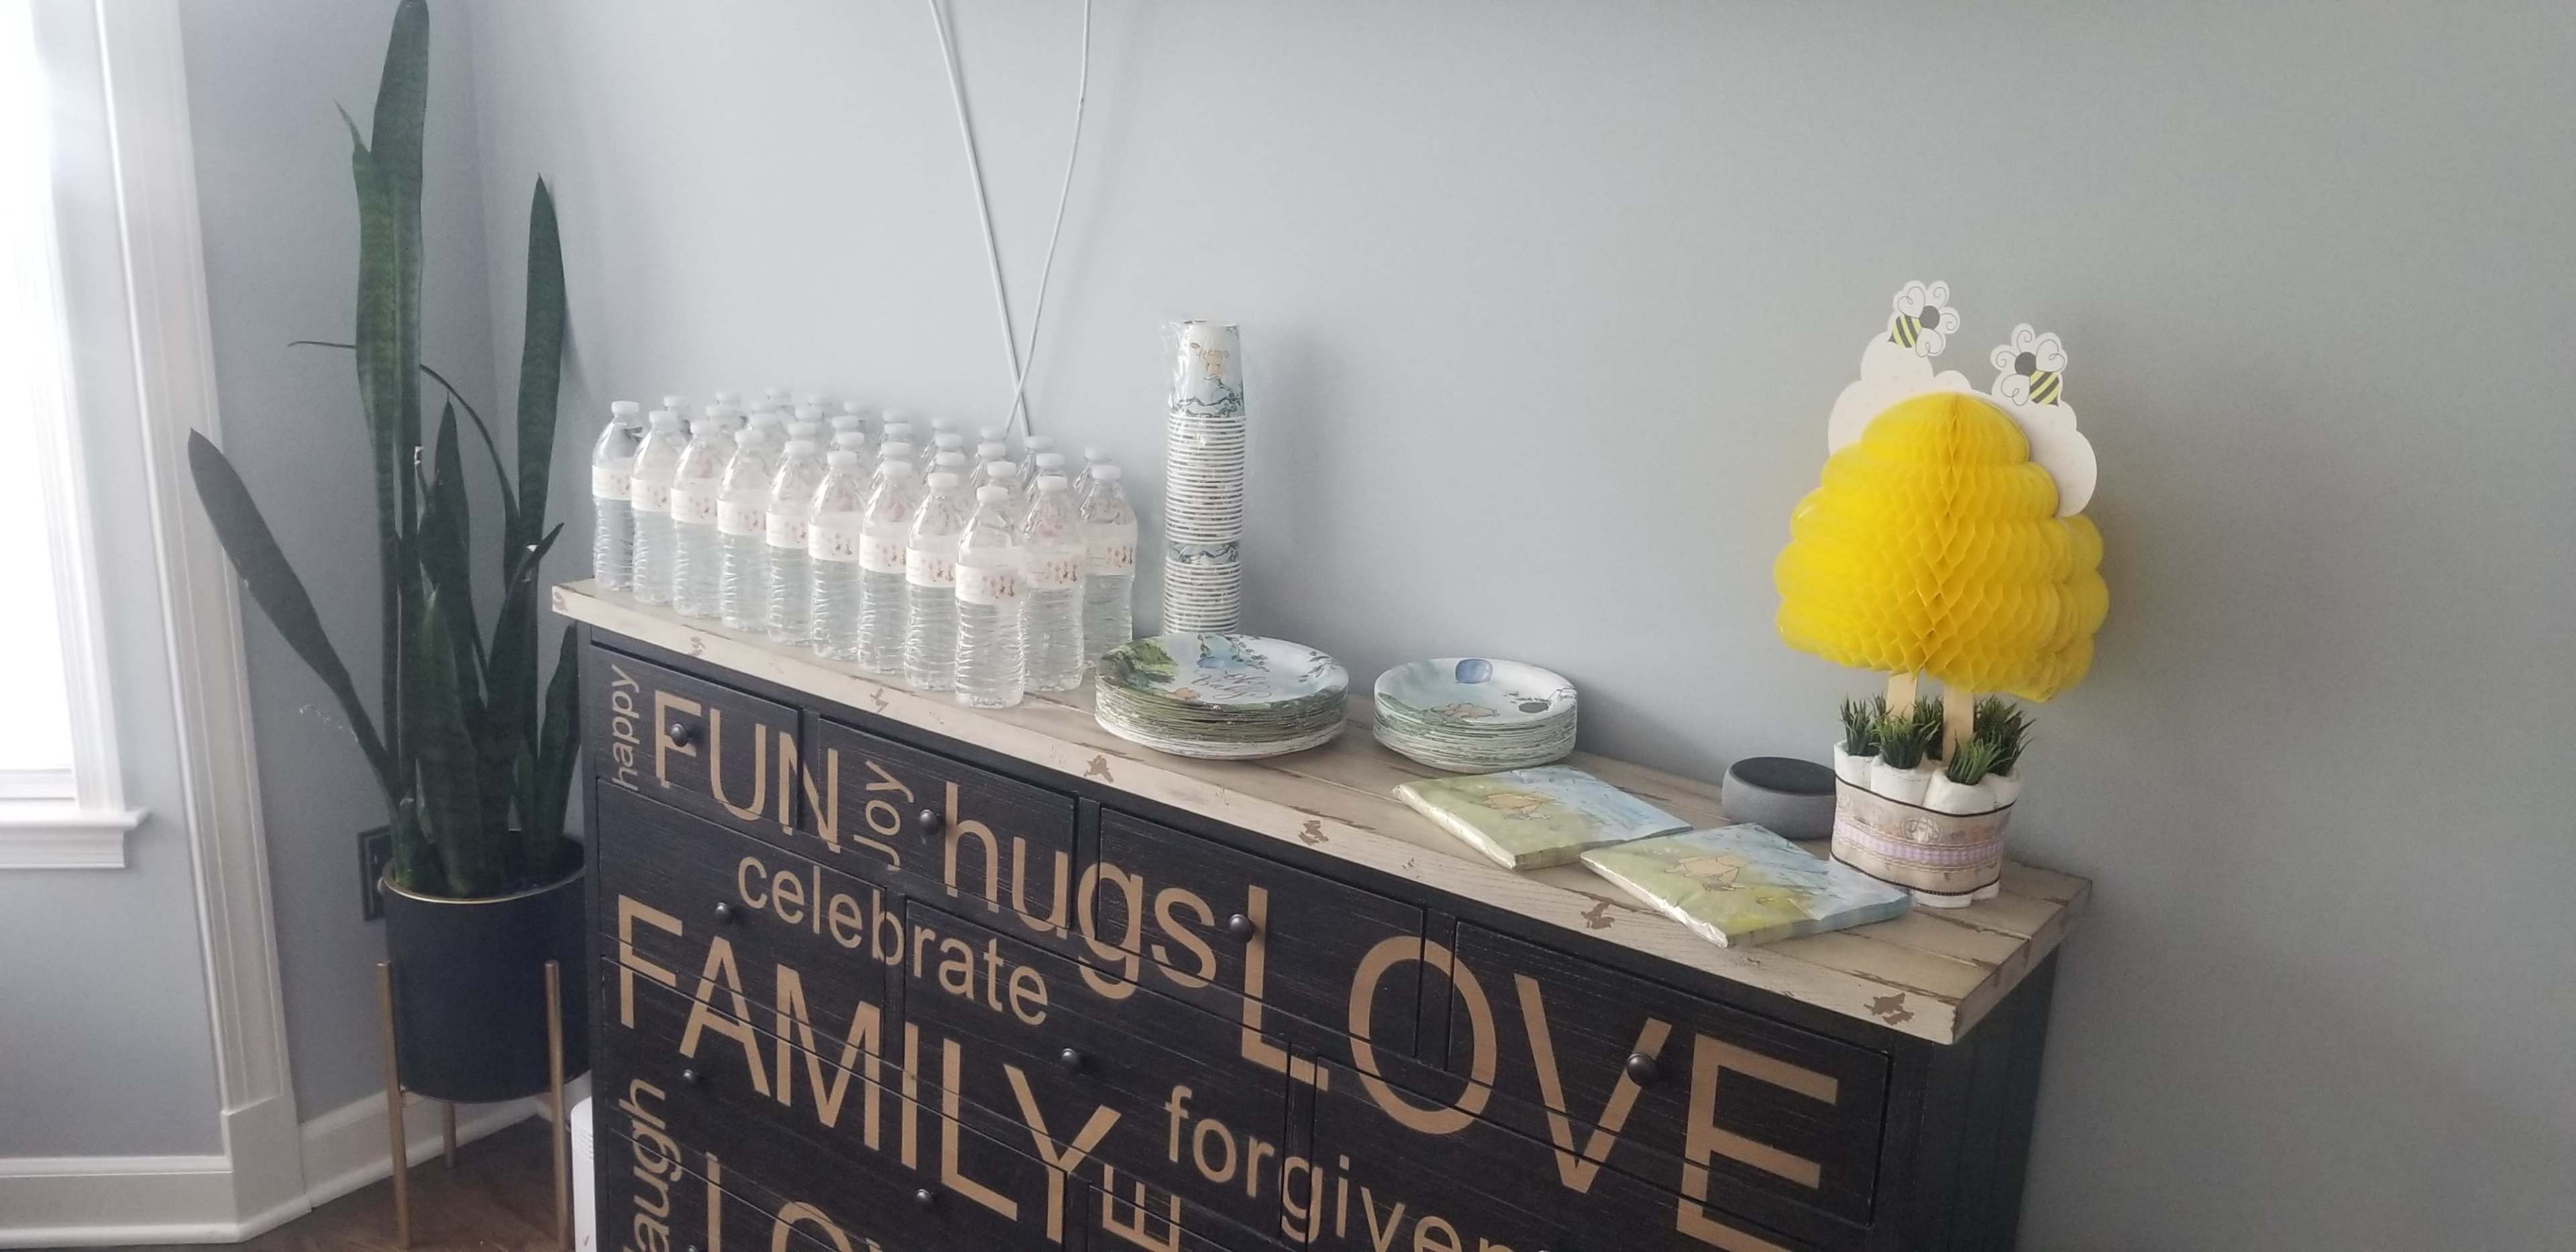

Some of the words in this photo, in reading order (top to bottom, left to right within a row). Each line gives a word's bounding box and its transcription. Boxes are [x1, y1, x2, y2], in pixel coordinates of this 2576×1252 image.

[612, 664, 640, 792] happy
[655, 690, 841, 853] FUN
[738, 856, 1049, 1026] celebrate
[945, 780, 1217, 1000] hugs
[618, 894, 1122, 1244] FAMILY
[1241, 884, 1839, 1252] LOVE
[618, 1079, 683, 1252] augh
[1165, 1086, 1515, 1252] forgive
